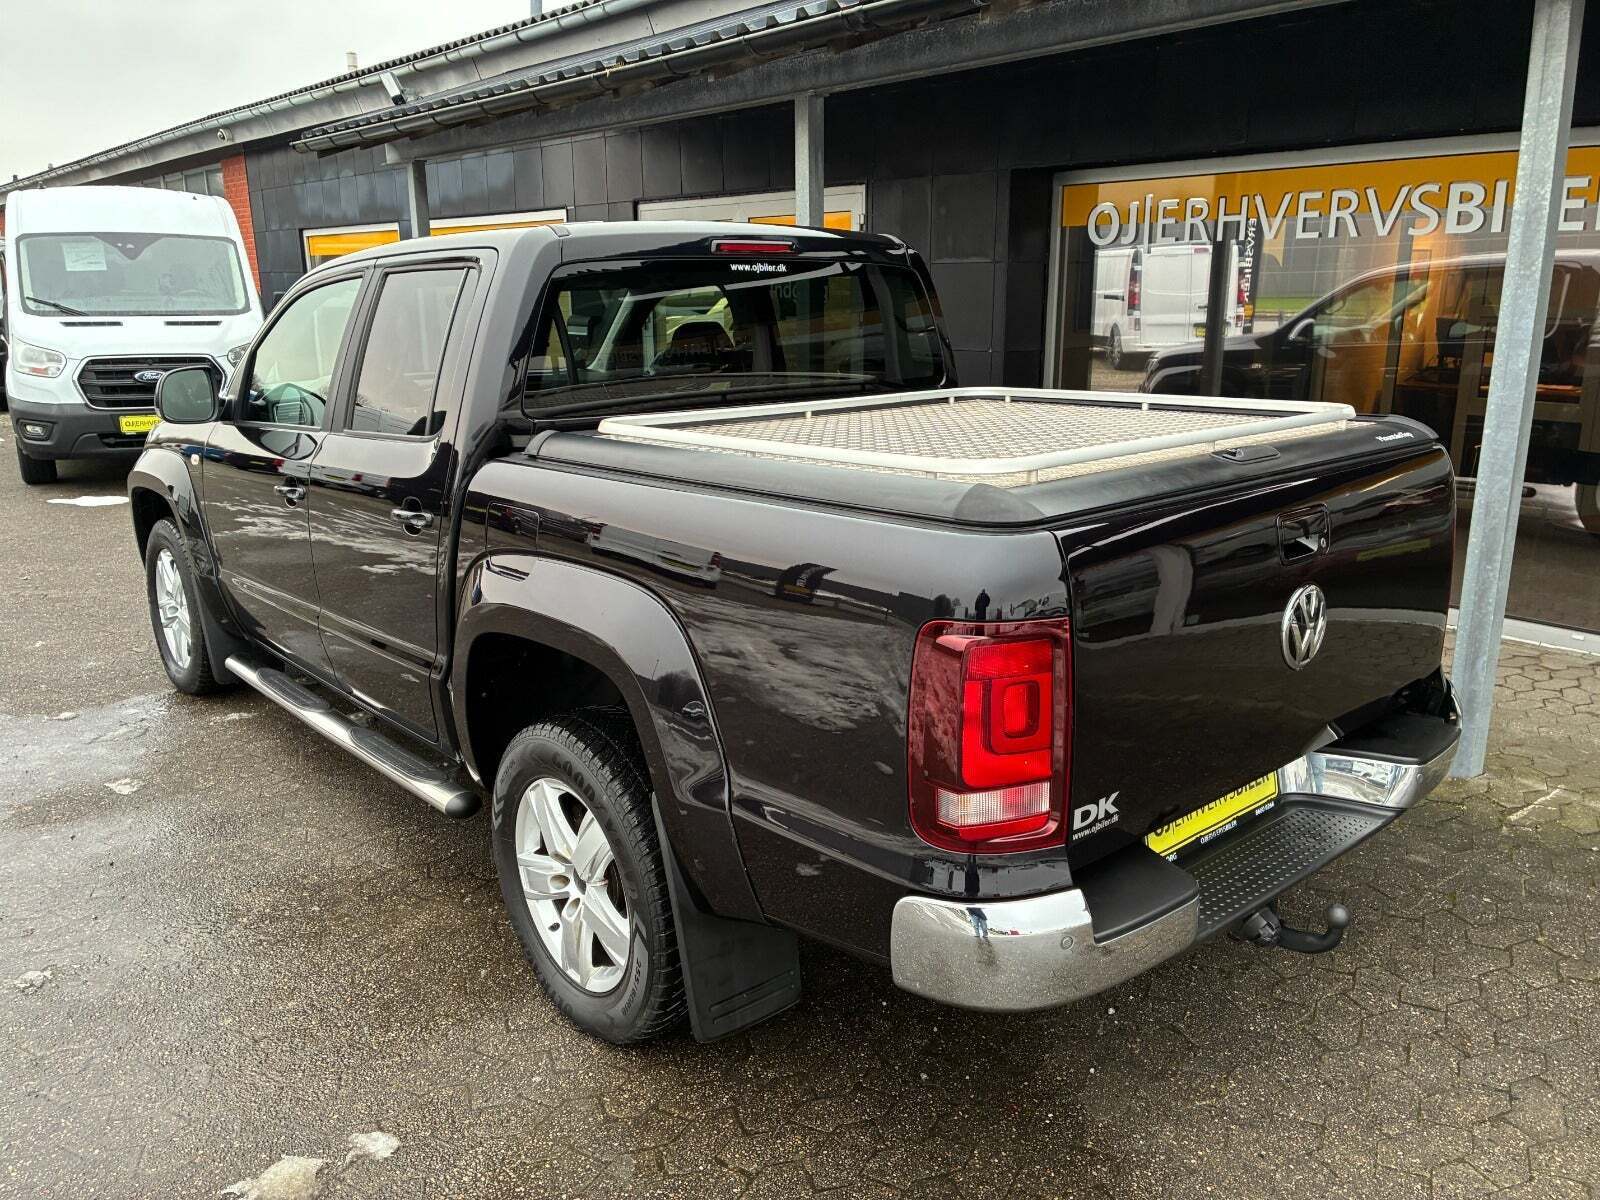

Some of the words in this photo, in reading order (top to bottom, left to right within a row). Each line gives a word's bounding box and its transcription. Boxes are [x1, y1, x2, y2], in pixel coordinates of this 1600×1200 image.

[730, 262, 788, 274] www.ojbiler.dk
[142, 372, 161, 381] Ford
[1072, 790, 1120, 831] DK
[1072, 813, 1120, 841] www.ojbiler.dk
